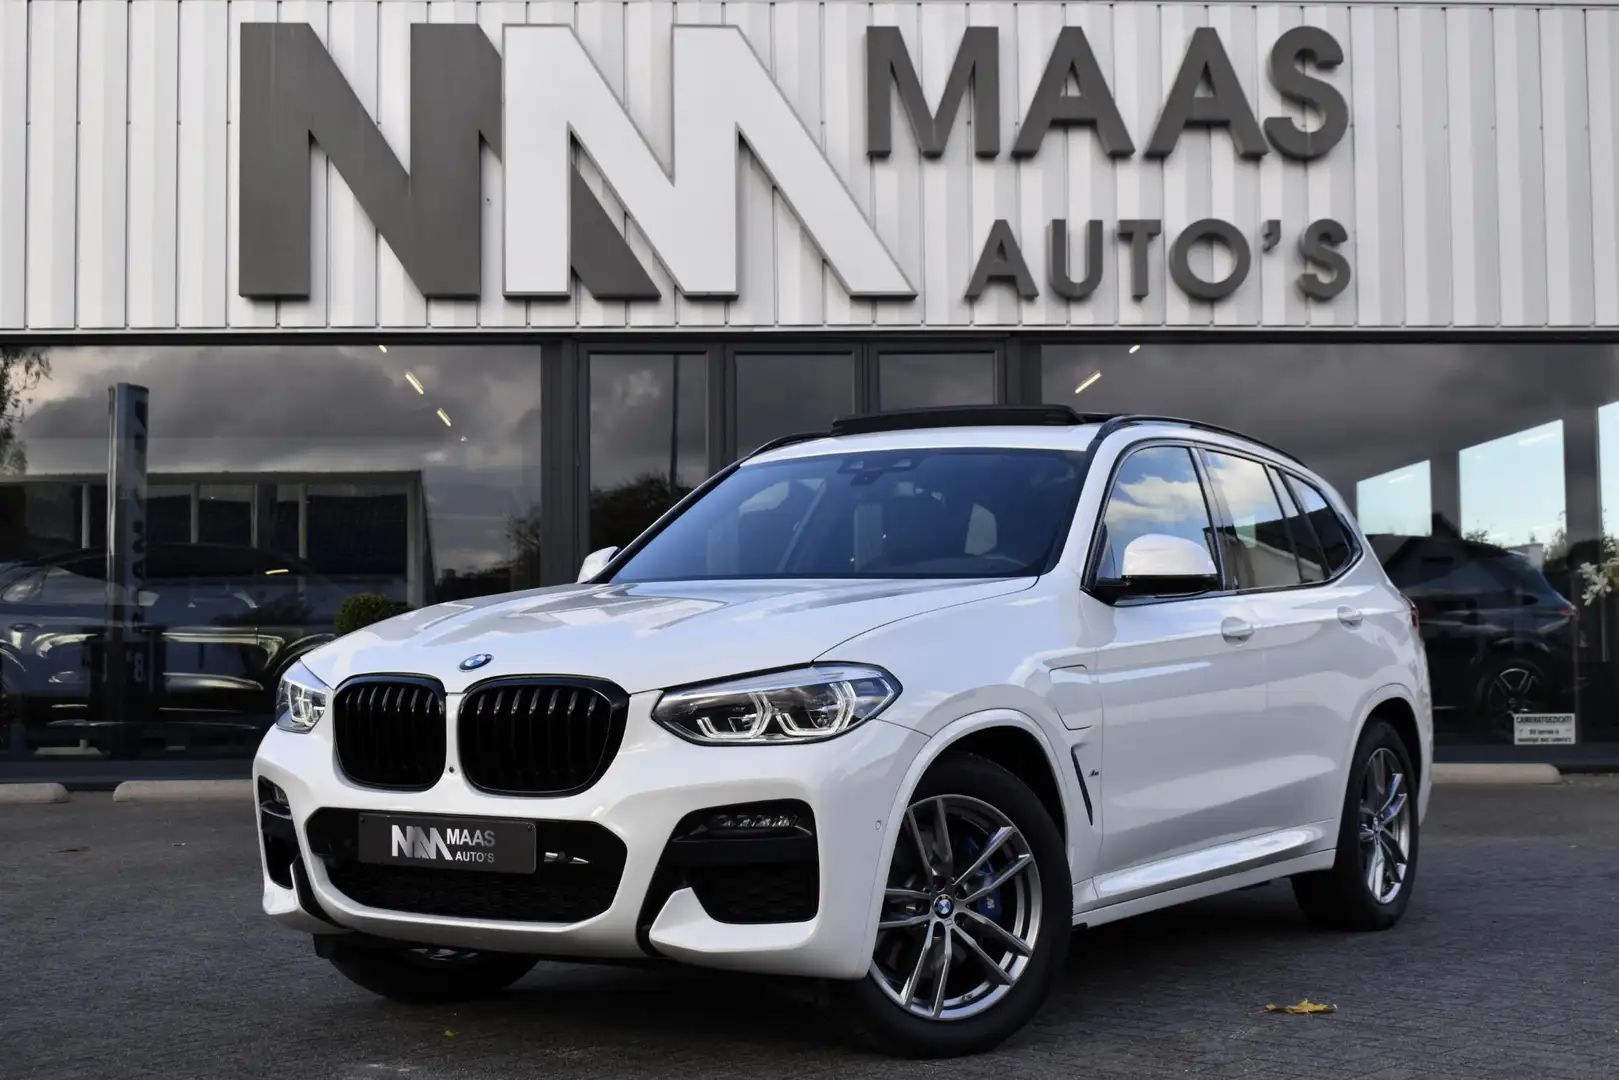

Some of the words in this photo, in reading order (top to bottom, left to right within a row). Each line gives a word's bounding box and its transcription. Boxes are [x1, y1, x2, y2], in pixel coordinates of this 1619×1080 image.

[866, 26, 1349, 160] MAAS
[963, 218, 1351, 302] AUTO'S
[446, 828, 496, 847] MAAS
[454, 851, 495, 863] AUTO'S
